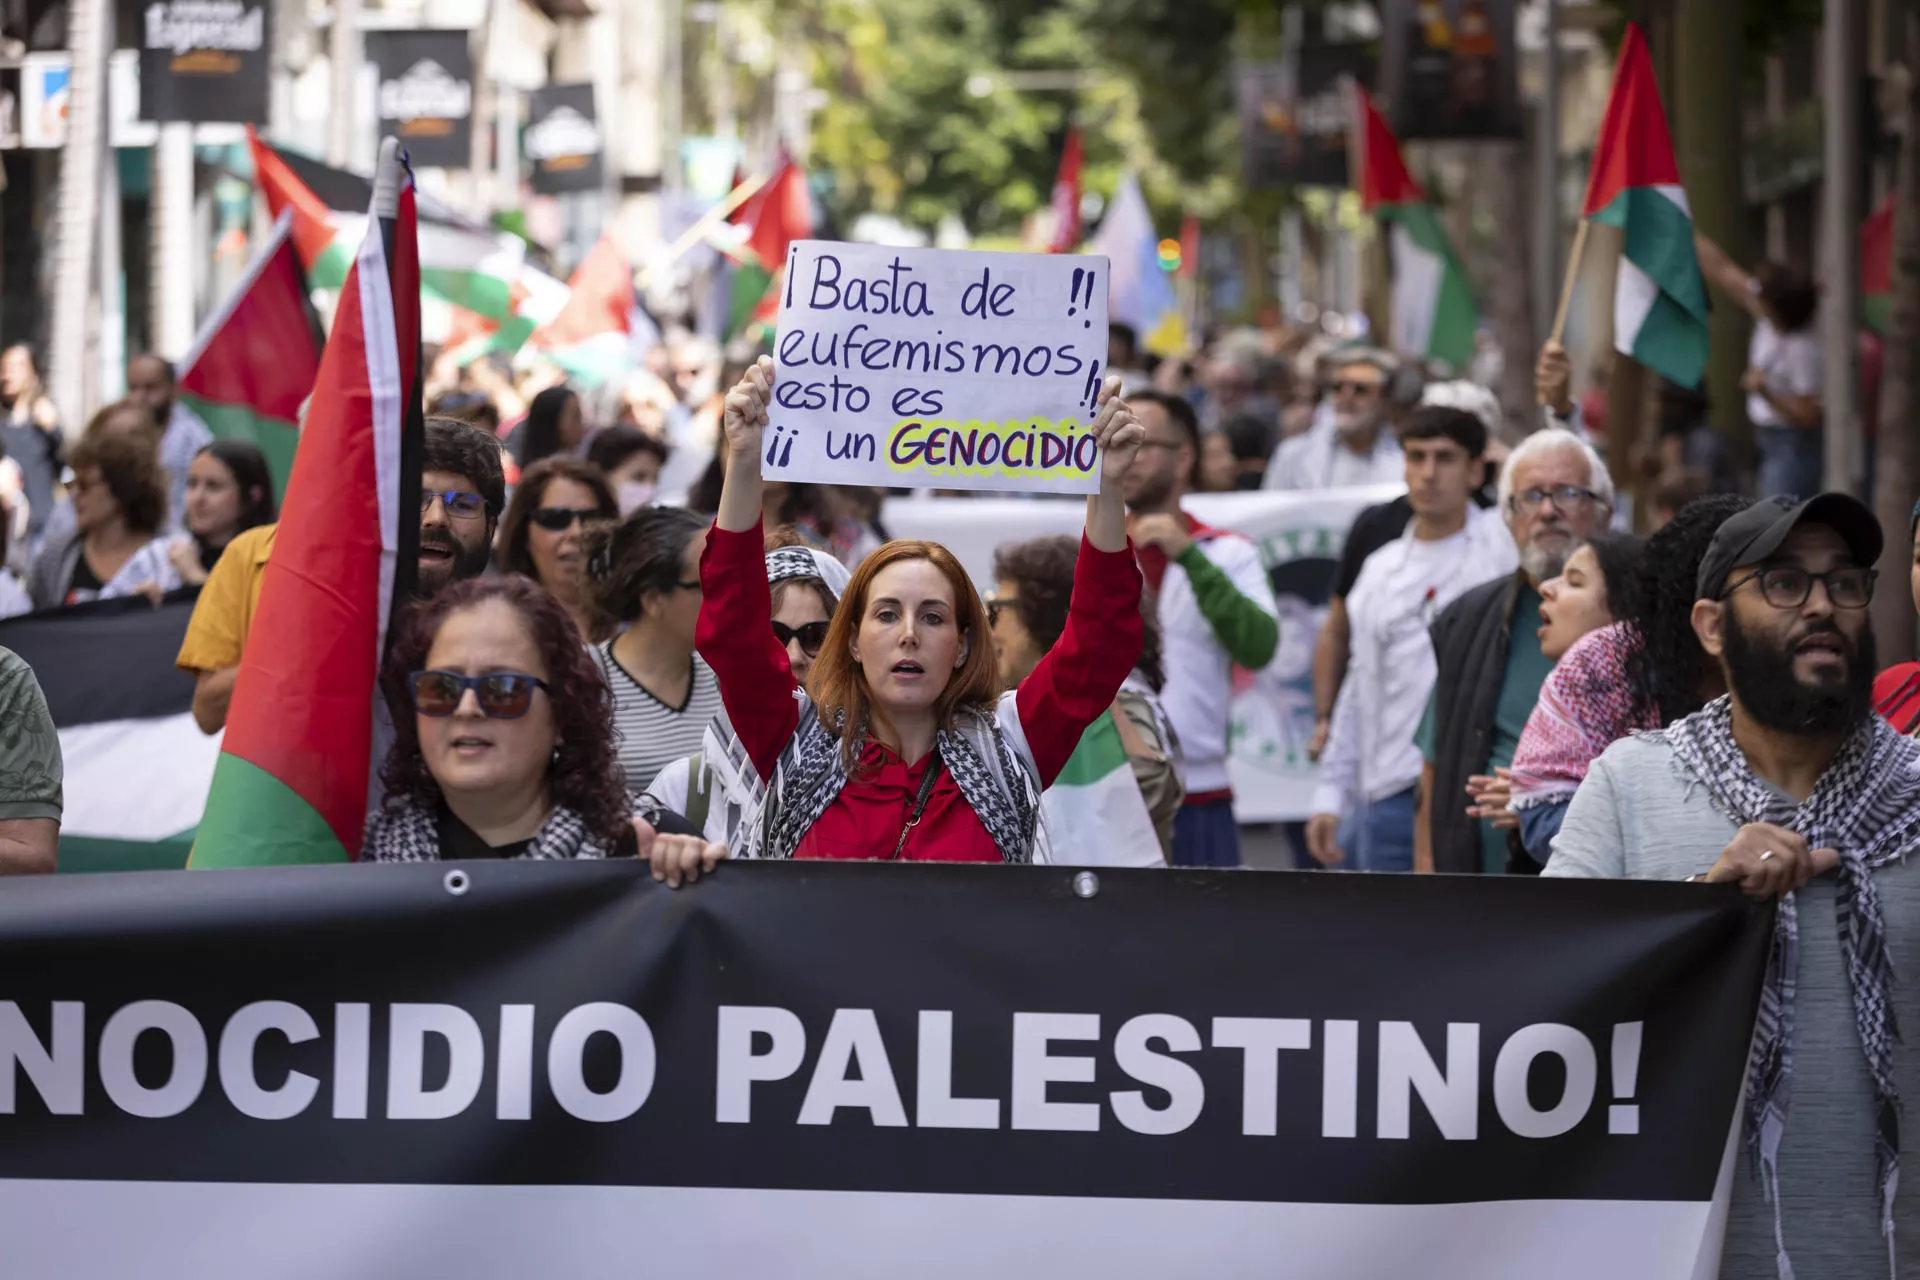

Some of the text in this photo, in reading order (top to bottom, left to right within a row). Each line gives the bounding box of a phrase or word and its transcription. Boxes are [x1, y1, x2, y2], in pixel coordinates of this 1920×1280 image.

[960, 266, 1016, 320] de
[779, 323, 1083, 377] eufemismos
[775, 374, 870, 413] esto
[891, 387, 944, 417] es
[826, 430, 876, 462] un
[0, 1000, 1643, 1140] NOCIDIO PALESTINO!
